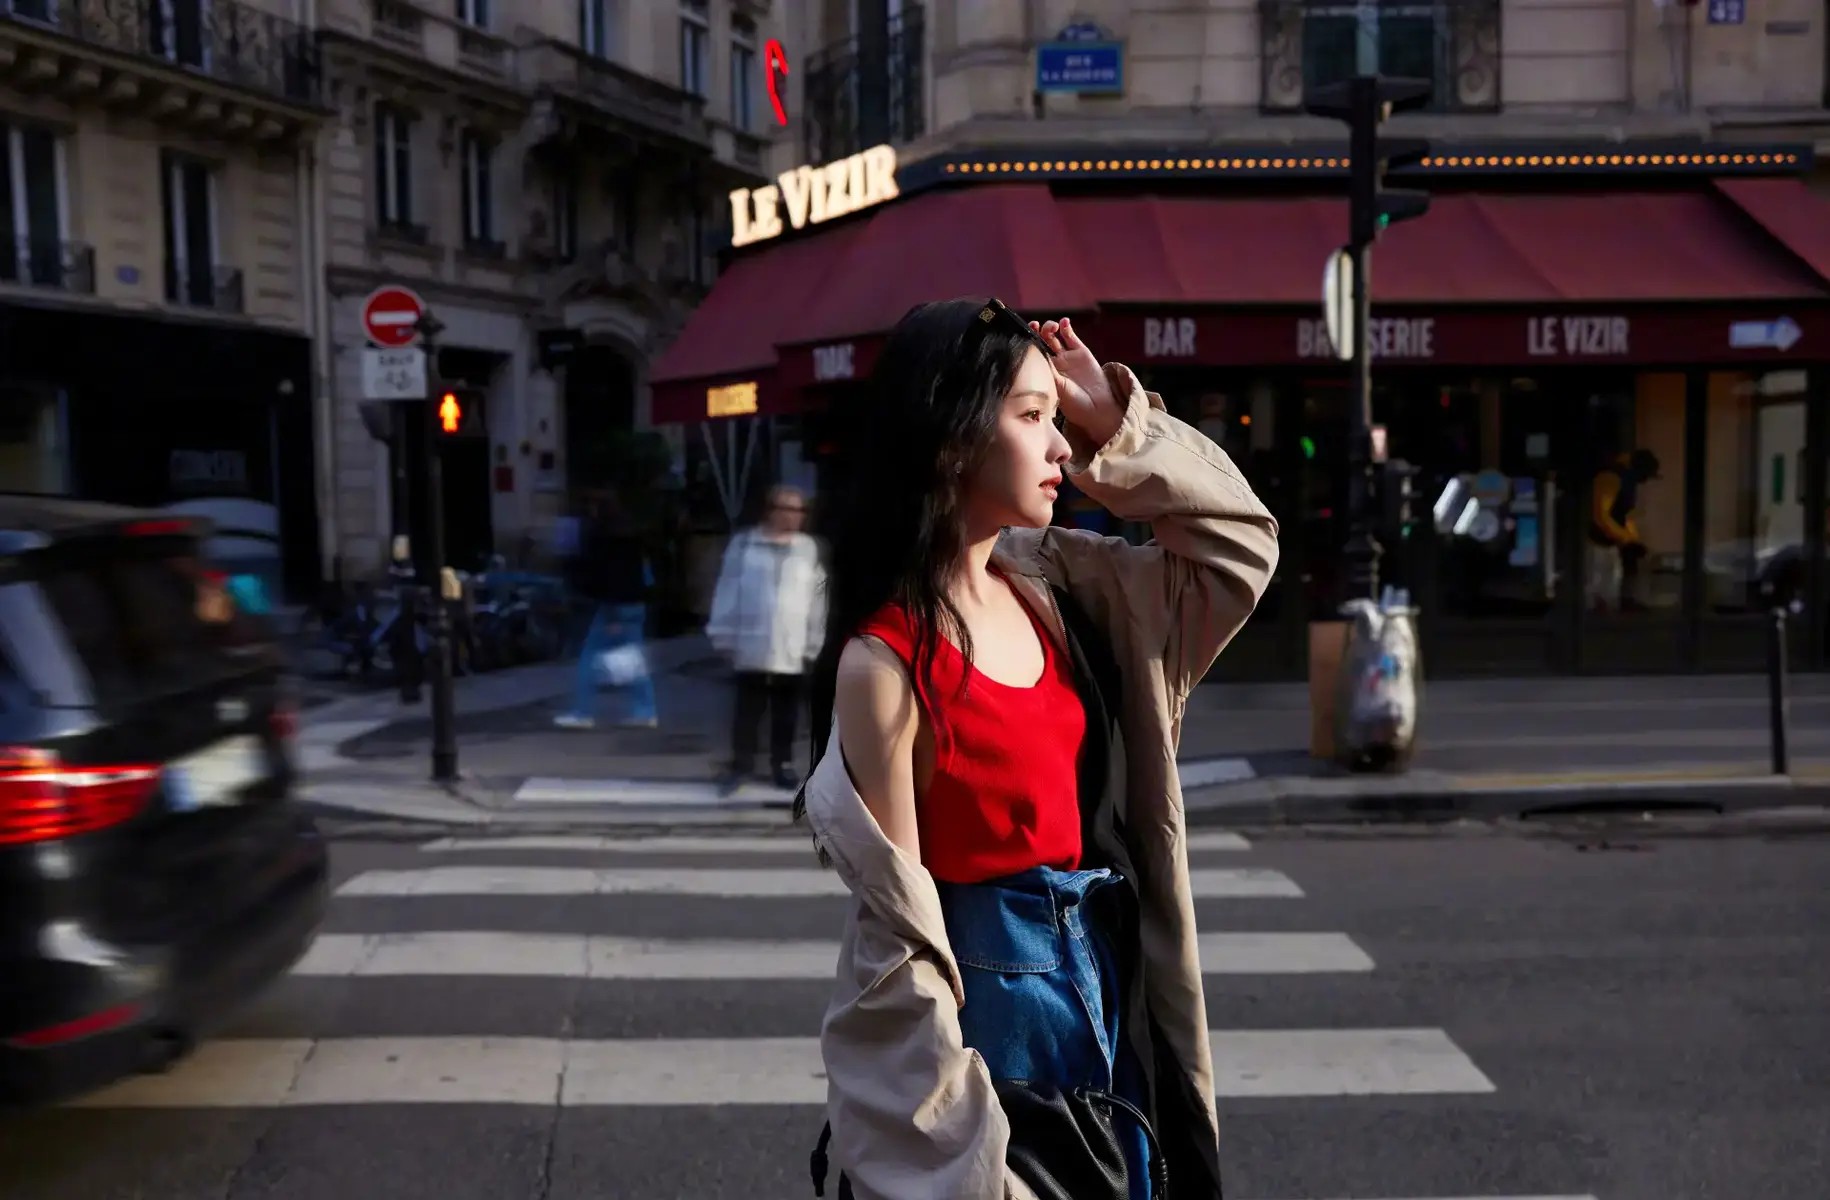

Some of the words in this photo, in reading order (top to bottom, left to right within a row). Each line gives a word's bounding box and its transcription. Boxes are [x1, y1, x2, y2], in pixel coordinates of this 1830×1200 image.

[729, 187, 783, 247] LE
[778, 144, 900, 230] VIZIR
[1144, 317, 1197, 356] BAR
[1296, 318, 1436, 357] BRSERIE
[1527, 316, 1558, 355] LE
[1562, 316, 1629, 355] VIZIR
